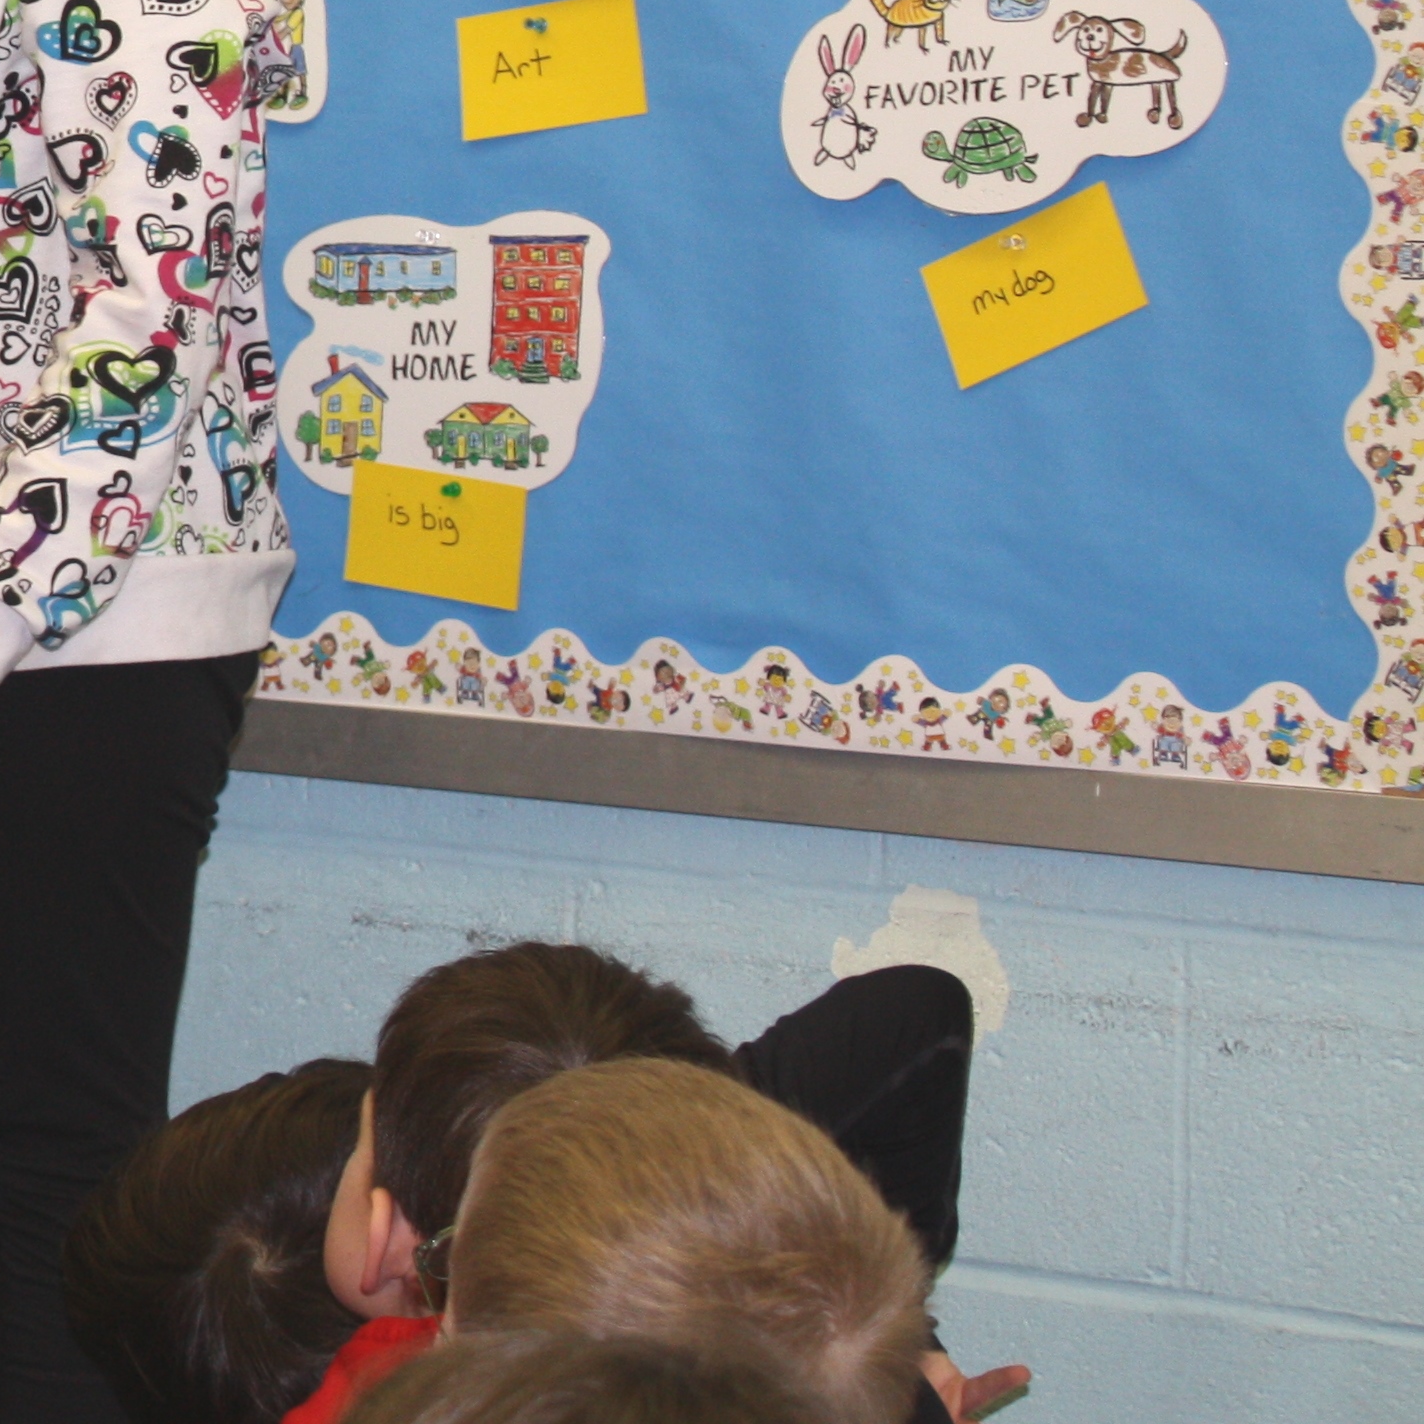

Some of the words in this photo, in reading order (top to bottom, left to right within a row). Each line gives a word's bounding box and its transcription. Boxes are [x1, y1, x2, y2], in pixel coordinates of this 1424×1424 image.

[492, 49, 552, 85] Art
[947, 45, 995, 73] MY
[863, 75, 1009, 111] FAVORITE
[1019, 71, 1081, 102] PET
[972, 287, 1011, 316] my
[1011, 267, 1056, 298] dog
[409, 319, 458, 348] MY
[390, 353, 478, 382] HOME
[388, 492, 411, 526] is
[420, 504, 461, 547] big
